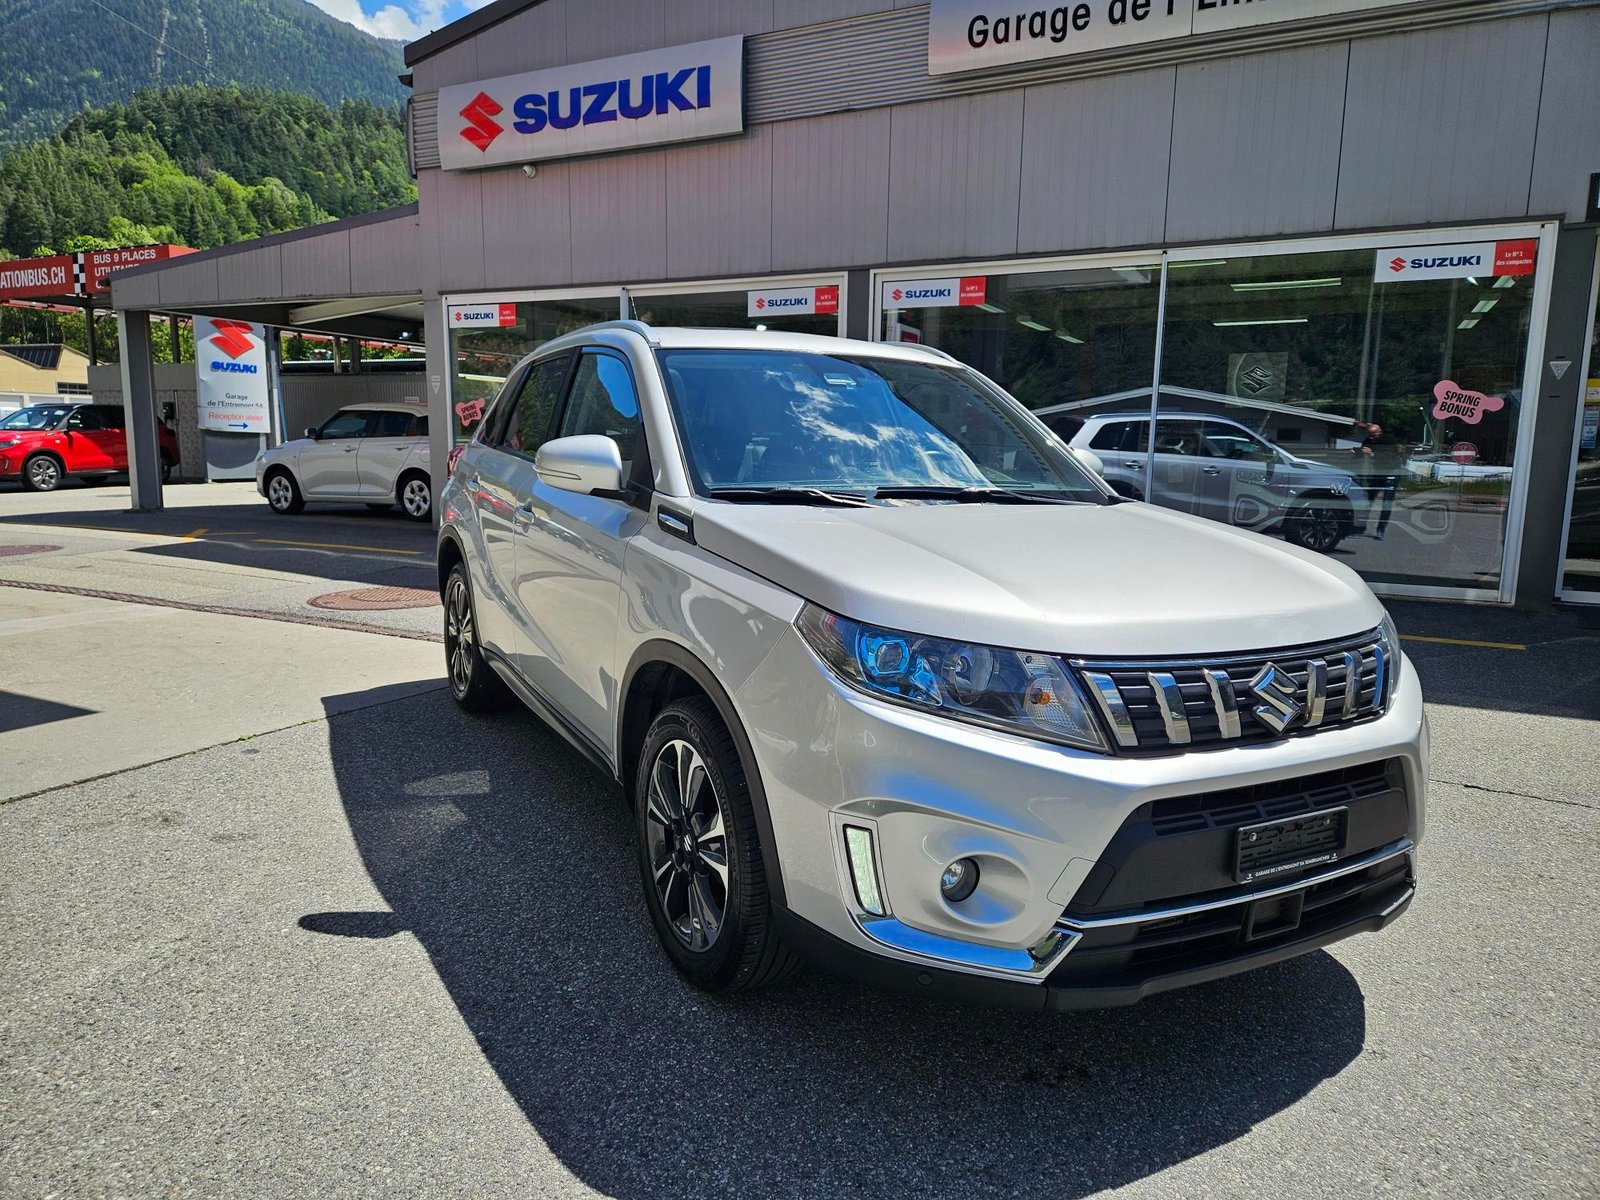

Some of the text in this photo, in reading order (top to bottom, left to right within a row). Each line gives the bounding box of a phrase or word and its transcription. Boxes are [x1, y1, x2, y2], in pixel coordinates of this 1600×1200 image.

[967, 3, 1091, 48] Garage
[1108, 0, 1151, 25] de
[513, 65, 711, 134] SUZUKI
[94, 249, 157, 264] BUS 9 PLACES
[1410, 255, 1482, 269] SUZUKI
[0, 266, 66, 289] ATIONBUS.CH
[905, 288, 951, 299] SUZUKI
[767, 297, 808, 308] SUZUKI
[463, 312, 494, 320] SUZUKI
[210, 361, 257, 374] SUZUKI
[225, 392, 248, 401] Garage
[1444, 390, 1481, 407] SPRING
[461, 403, 476, 414] SPRING
[1439, 401, 1476, 418] BONUS
[463, 410, 478, 421] BONUS
